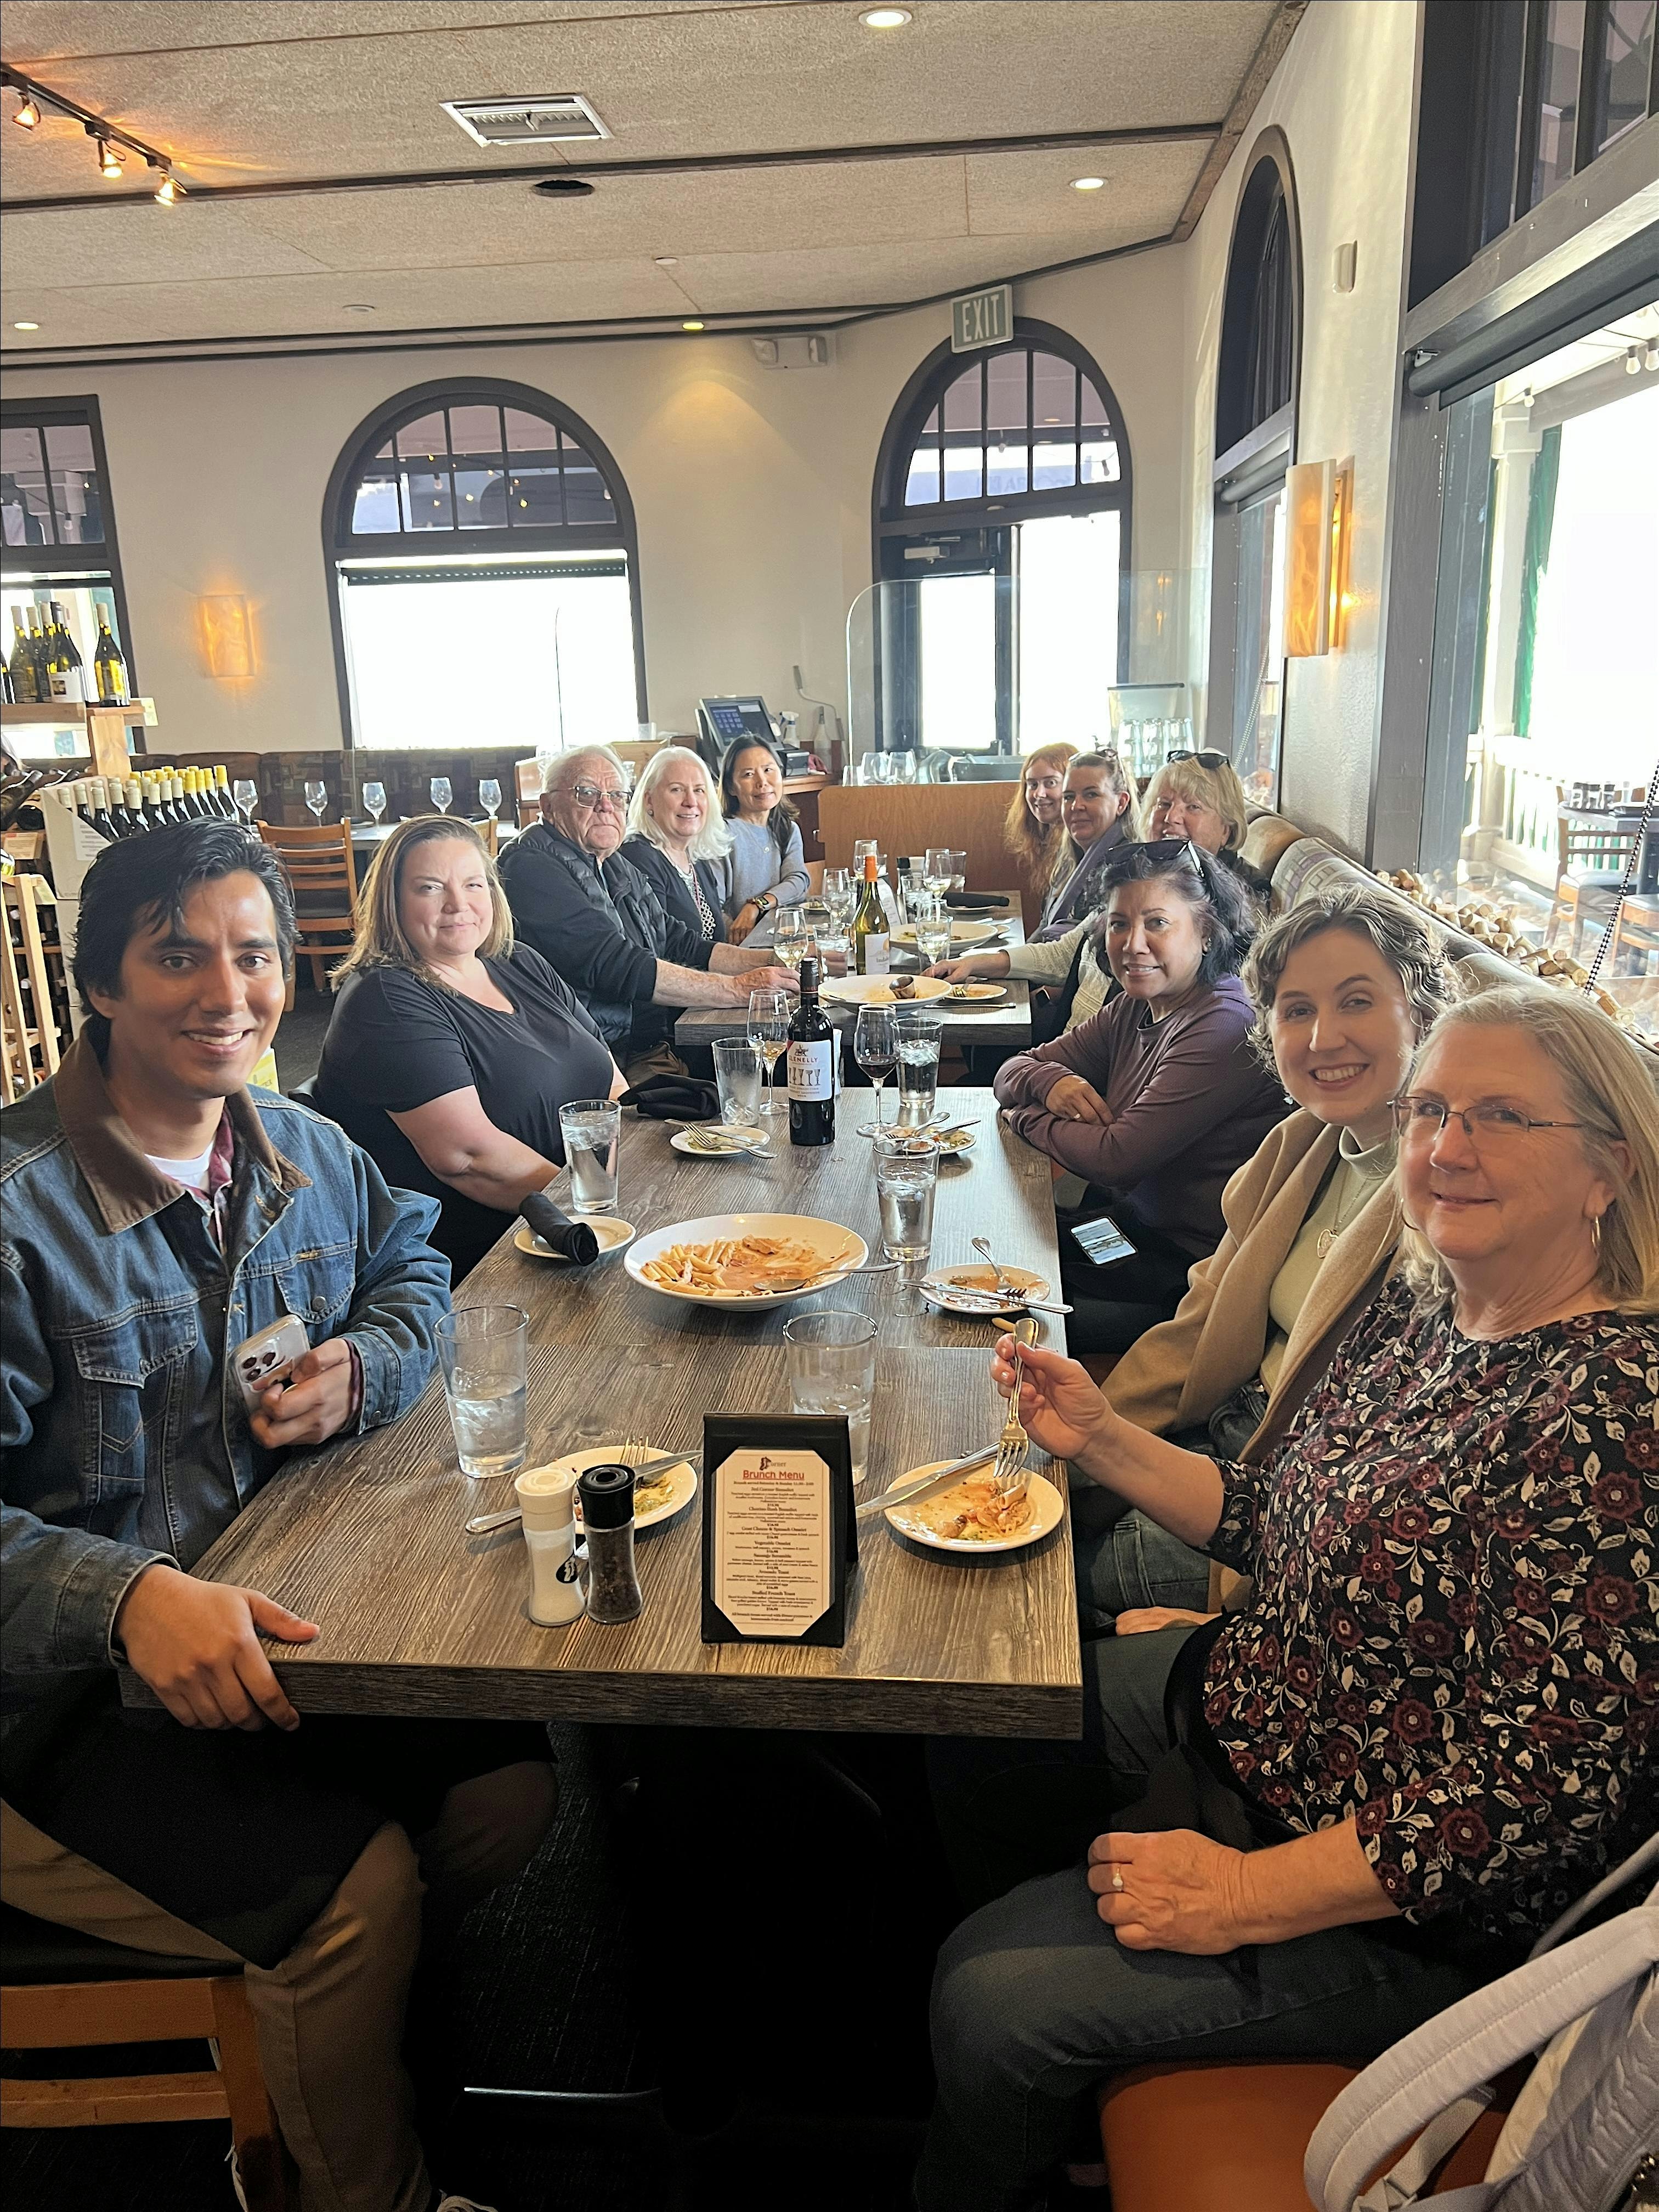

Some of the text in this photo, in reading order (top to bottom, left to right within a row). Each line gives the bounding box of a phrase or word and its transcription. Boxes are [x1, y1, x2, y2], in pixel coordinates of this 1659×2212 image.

[962, 294, 999, 342] EXIT
[743, 1470, 805, 1480] Brunch Menu
